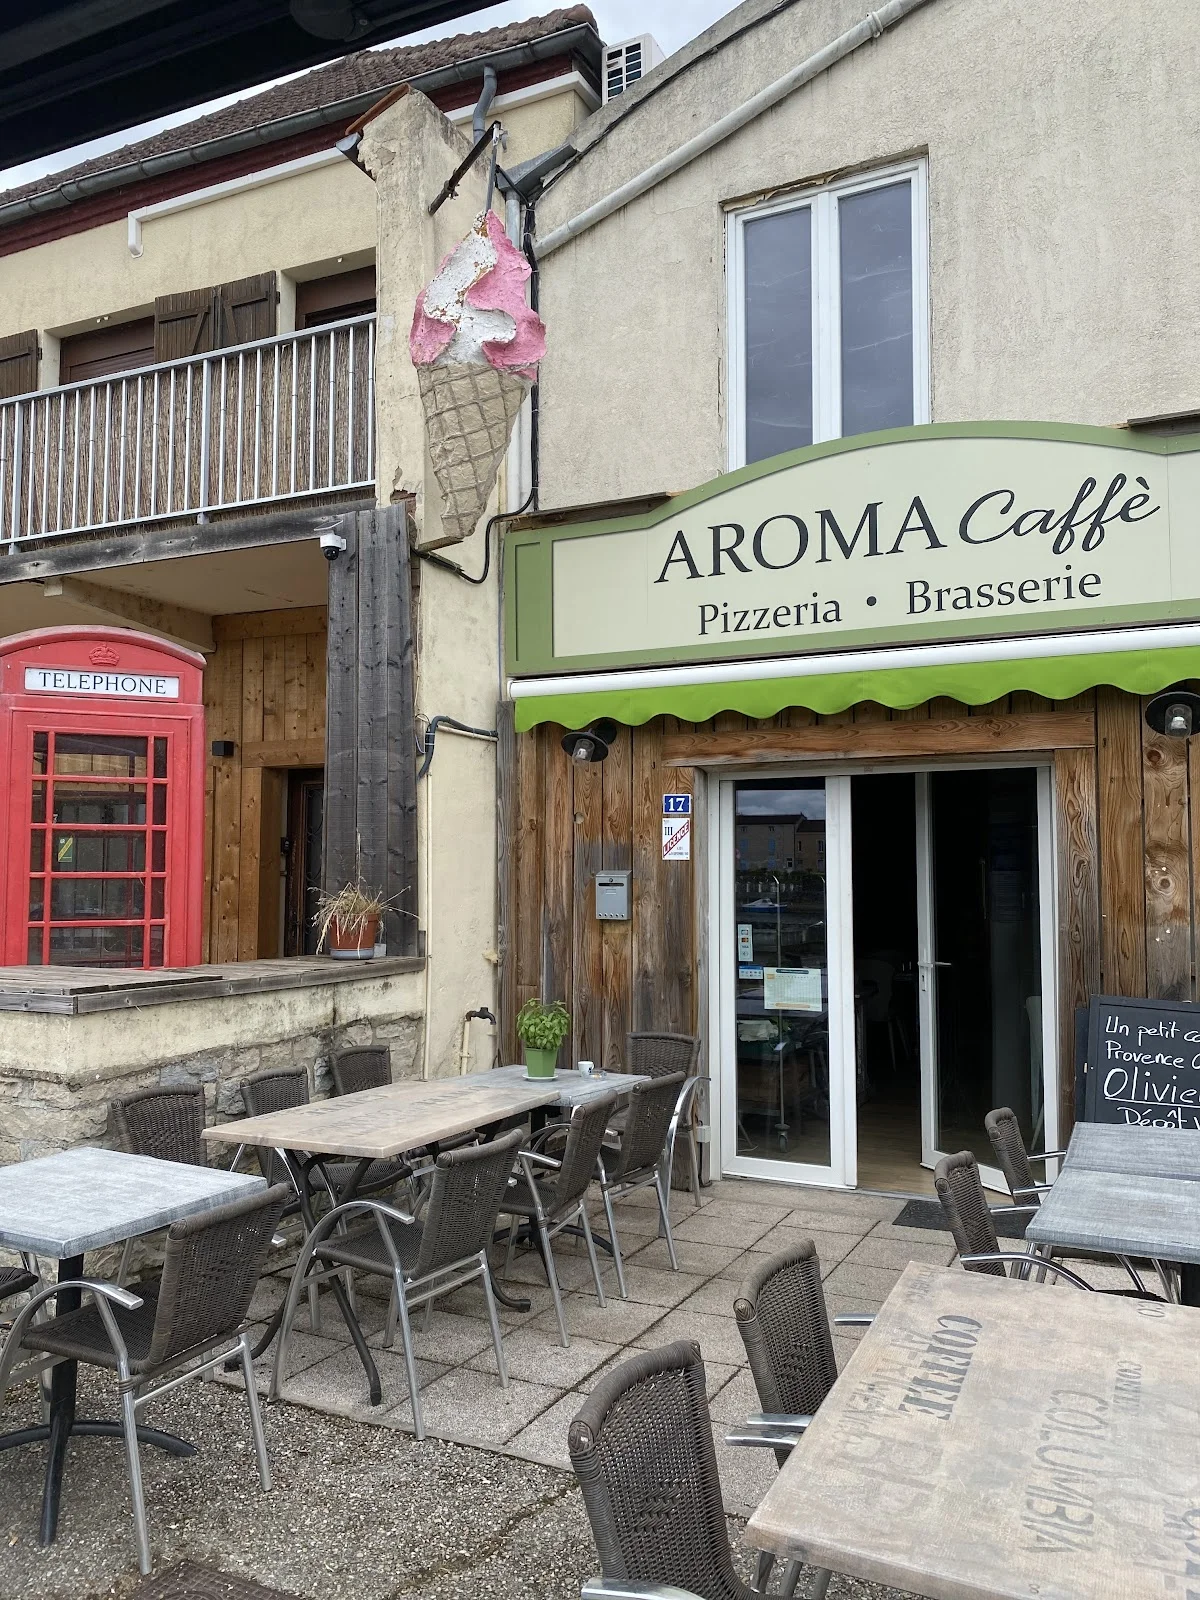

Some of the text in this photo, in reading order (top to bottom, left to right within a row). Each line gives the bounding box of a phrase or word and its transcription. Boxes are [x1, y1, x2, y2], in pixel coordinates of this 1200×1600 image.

[654, 473, 1161, 584] AROMA Caffè
[698, 564, 1102, 636] Pizzeria Brasserie
[38, 670, 167, 695] TELEPHONE
[668, 797, 685, 811] 17
[664, 823, 689, 855] LICENCE
[1105, 1015, 1130, 1036] Un
[1137, 1021, 1181, 1047] petit
[1105, 1040, 1185, 1069] Provence
[898, 1314, 984, 1421] COFFEE
[1020, 1389, 1109, 1553] COLUMBIA
